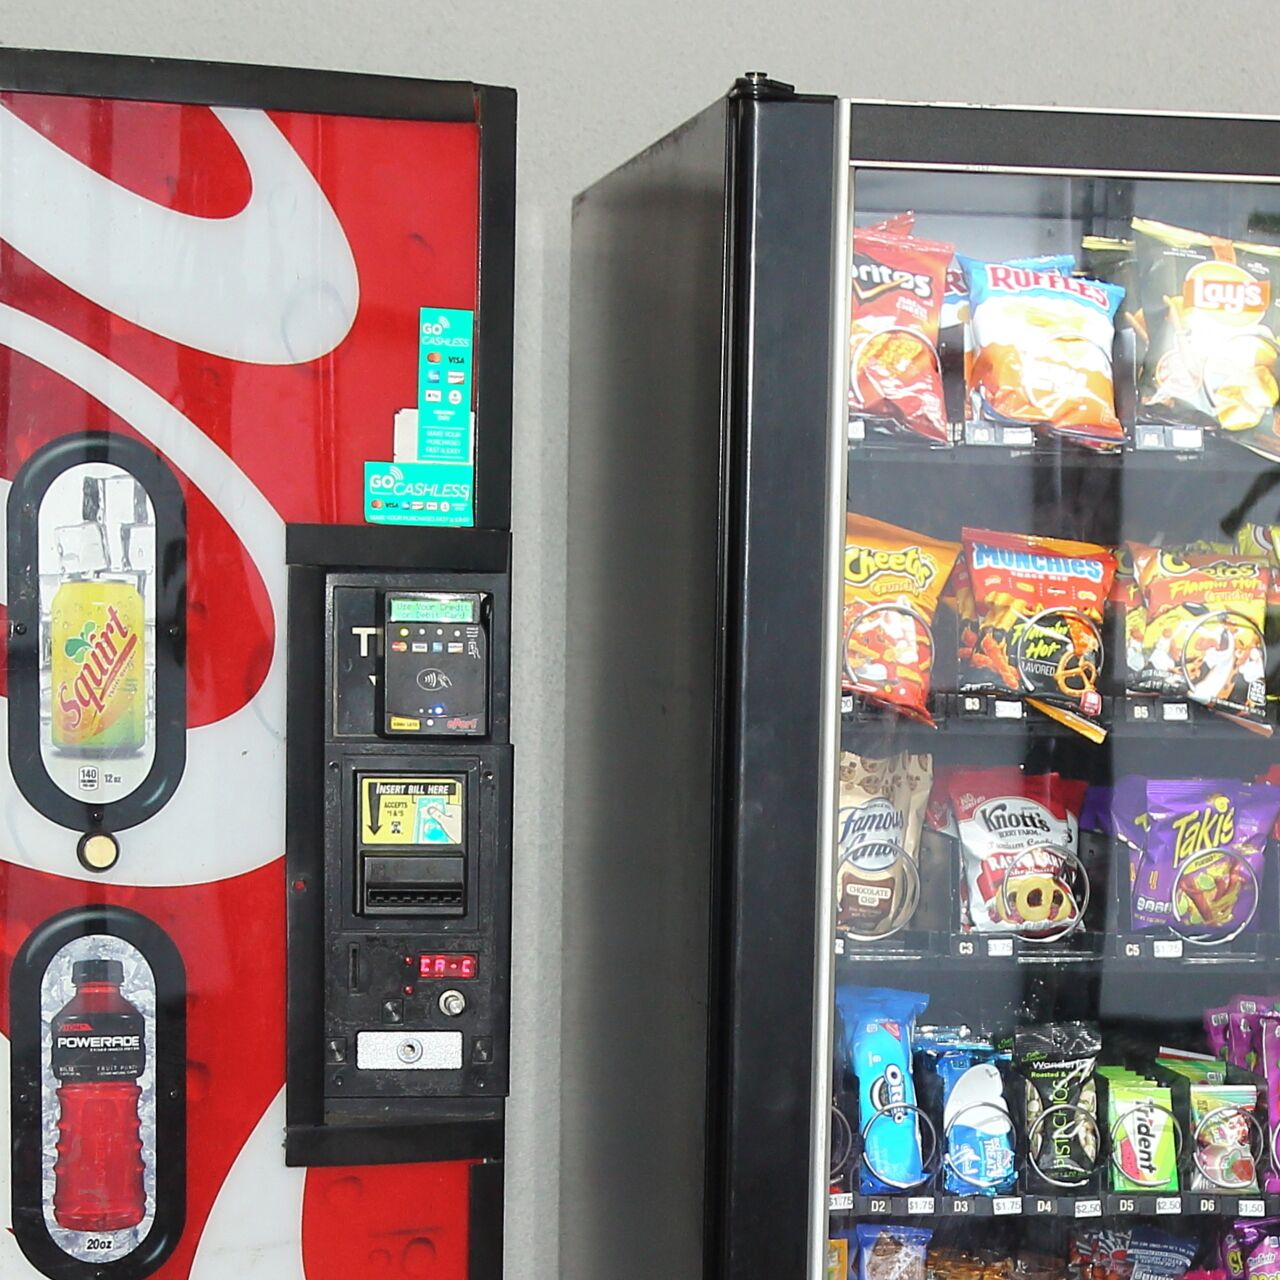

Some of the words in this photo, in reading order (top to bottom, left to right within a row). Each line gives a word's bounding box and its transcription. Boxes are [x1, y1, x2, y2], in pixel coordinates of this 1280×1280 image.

[986, 263, 1110, 309] RUFFLES
[1193, 277, 1261, 312] Lay's
[423, 322, 443, 335] GO
[422, 336, 469, 347] CASHLESS
[448, 356, 464, 364] VISA
[370, 474, 394, 489] GO
[393, 482, 469, 501] CASHLESS
[397, 602, 412, 610] Use
[416, 602, 435, 610] Your
[440, 602, 469, 611] Credit
[1025, 641, 1061, 658] Hot
[58, 604, 134, 730] Squirt
[965, 698, 979, 709] B3
[1134, 706, 1148, 718] B5
[80, 769, 97, 780] 140
[376, 783, 406, 795] INSERT
[408, 784, 426, 795] BILL
[428, 785, 449, 794] HERE
[384, 801, 408, 809] ACCEPTS
[980, 803, 1051, 832] Knott's
[1172, 795, 1235, 868] Takis
[849, 886, 889, 897] CHOCOLATE
[959, 942, 973, 954] C3
[1125, 945, 1140, 957] C5
[57, 1036, 140, 1048] POWERADE
[1135, 1096, 1157, 1174] Trident
[871, 1200, 885, 1212] D2
[909, 1201, 934, 1211] $1.75
[954, 1200, 968, 1212] D3
[995, 1201, 1021, 1211] $1.75
[1037, 1200, 1052, 1212] D4
[1076, 1203, 1101, 1213] $2.50
[1120, 1200, 1134, 1212] D5
[1200, 1200, 1215, 1212] D6
[86, 1238, 113, 1252] 20oz
